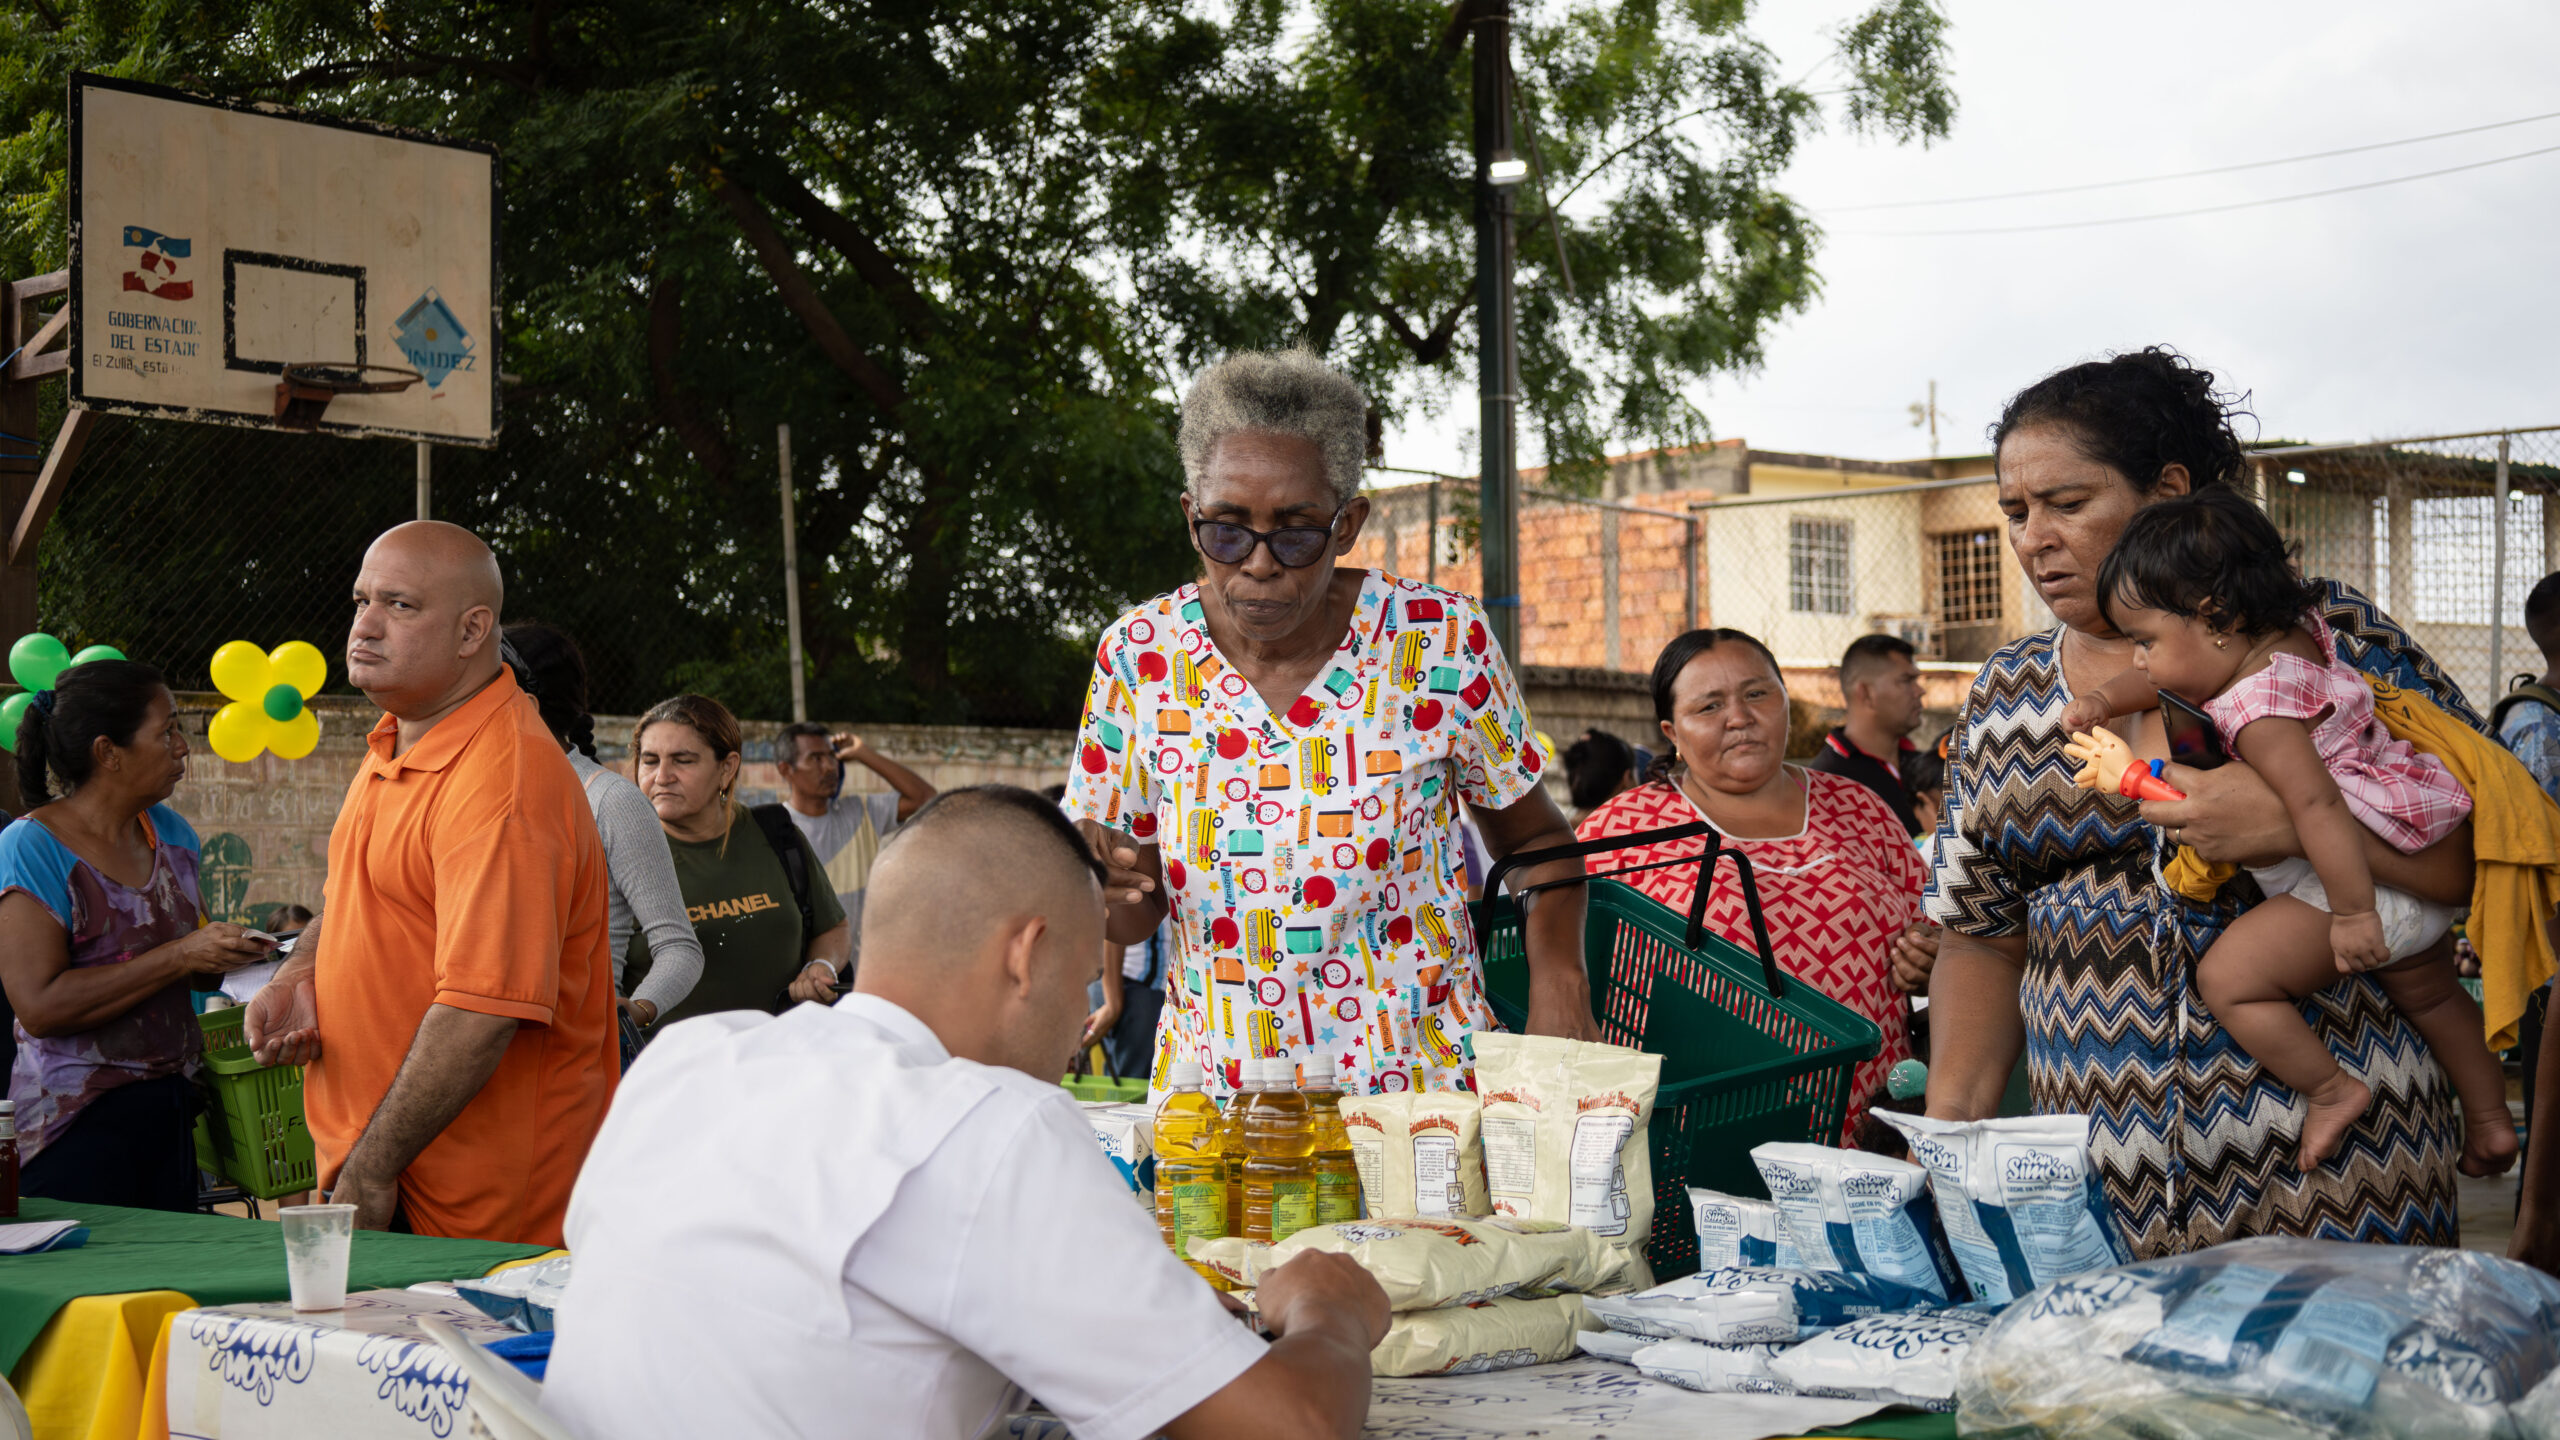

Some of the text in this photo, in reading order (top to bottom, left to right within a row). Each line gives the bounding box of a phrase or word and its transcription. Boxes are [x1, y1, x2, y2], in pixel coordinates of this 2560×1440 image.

[111, 333, 136, 351] DEL
[1447, 622, 1456, 650] imagine
[1198, 768, 1207, 796] imagine
[1300, 811, 1309, 840] imagine
[1285, 847, 1294, 870] days
[1223, 872, 1233, 900] amazing
[686, 893, 780, 922] CHANEL
[1225, 1003, 1233, 1032] Smart!
[1380, 1017, 1390, 1045] imagine
[1576, 1091, 1640, 1116] Montaña Fresca
[1362, 1112, 1385, 1134] Fresca
[1410, 1114, 1460, 1136] Montaña Fresca
[1770, 1163, 1794, 1178] San
[2007, 1156, 2077, 1184] Simón
[2026, 1148, 2053, 1167] San
[1846, 1177, 1901, 1204] Simón
[1859, 1172, 1885, 1187] San
[1704, 1209, 1737, 1225] Simón
[225, 1352, 275, 1407] San
[397, 1380, 453, 1438] San
